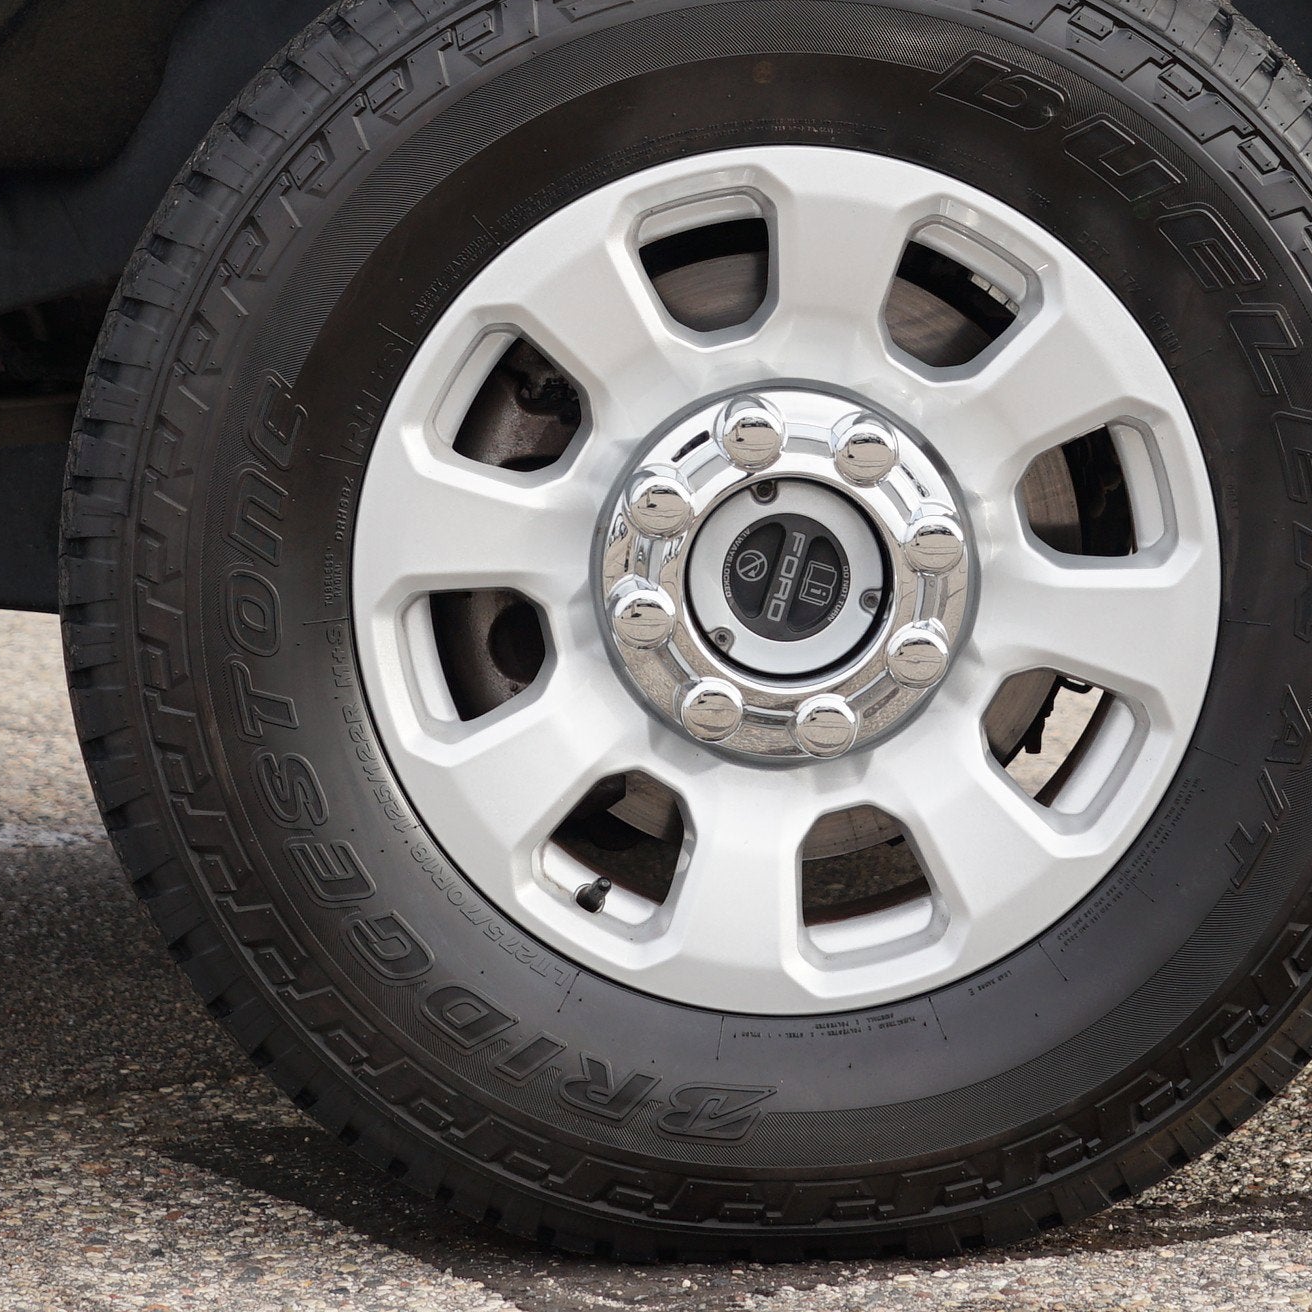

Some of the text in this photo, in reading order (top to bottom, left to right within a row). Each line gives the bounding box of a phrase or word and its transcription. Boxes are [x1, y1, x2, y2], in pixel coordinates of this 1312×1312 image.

[323, 552, 333, 609] TUBELESS
[332, 560, 342, 599] RADIAL
[722, 526, 752, 598] ALWAYS LOCKED
[766, 531, 806, 622] FORD
[825, 564, 849, 623] DO NOT TURN
[224, 374, 777, 1140] BRIDGESTONE
[324, 623, 571, 988] LT275/70R18 125/122R M+S
